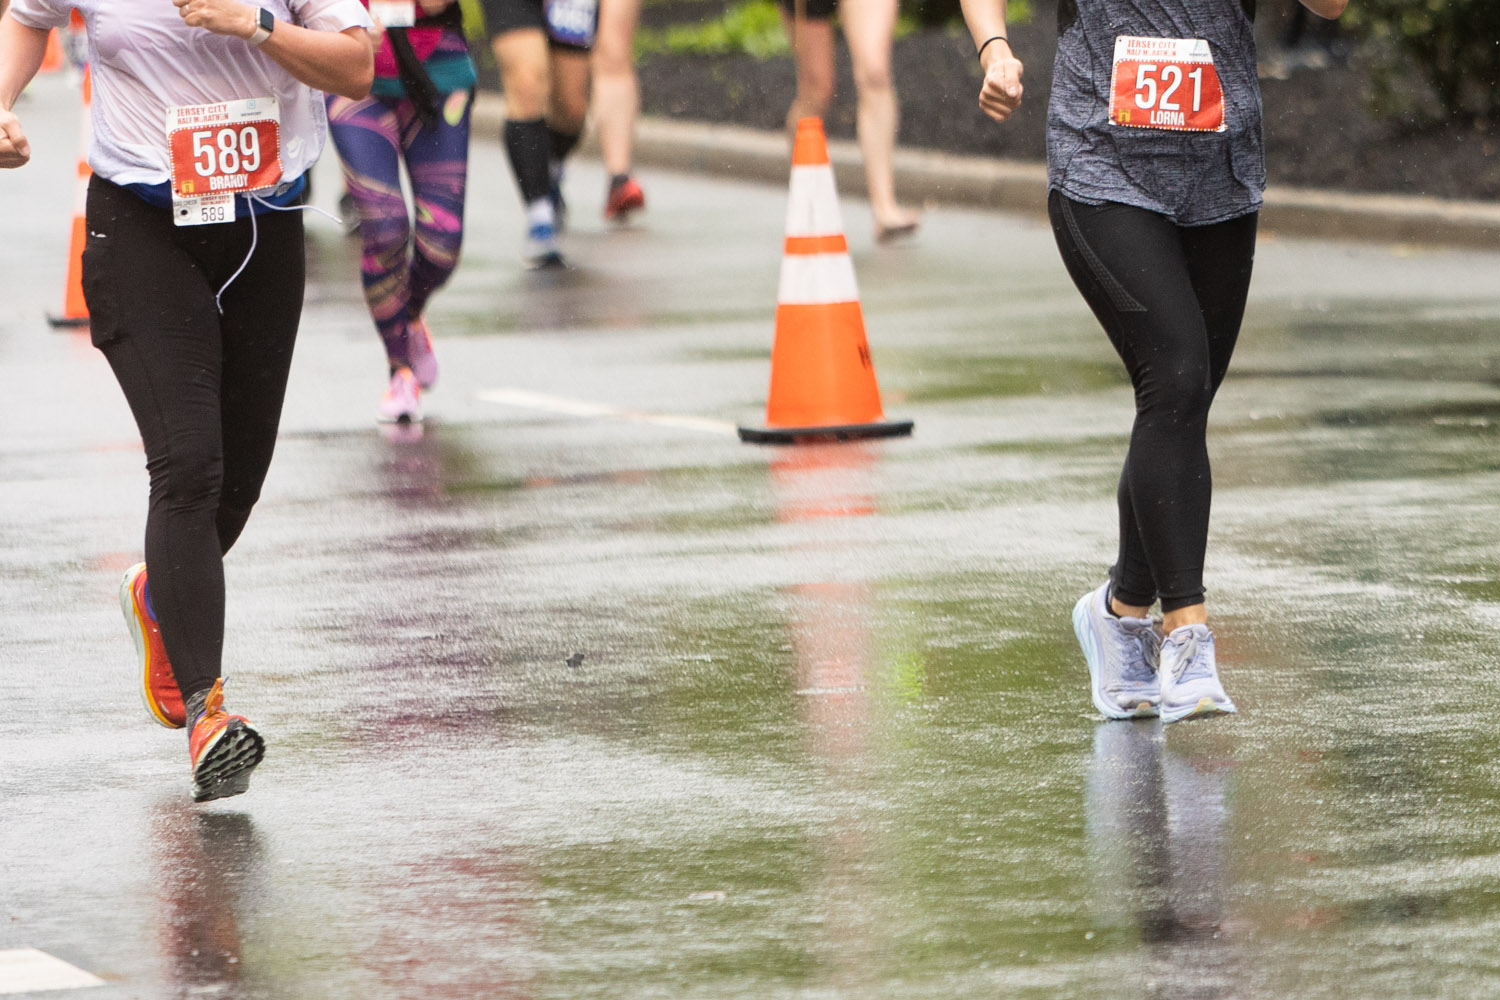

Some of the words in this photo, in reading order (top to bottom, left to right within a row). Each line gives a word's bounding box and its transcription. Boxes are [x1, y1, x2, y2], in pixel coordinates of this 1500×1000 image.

[1128, 40, 1156, 49] JERSEY
[1158, 40, 1177, 49] CITY
[1134, 64, 1203, 112] 521
[177, 105, 206, 117] JERSEY
[208, 104, 228, 115] CITY
[1150, 110, 1185, 126] LORNA
[177, 116, 193, 125] HALF
[192, 126, 261, 177] 589
[209, 174, 249, 191] BRANDY
[201, 206, 225, 222] 589
